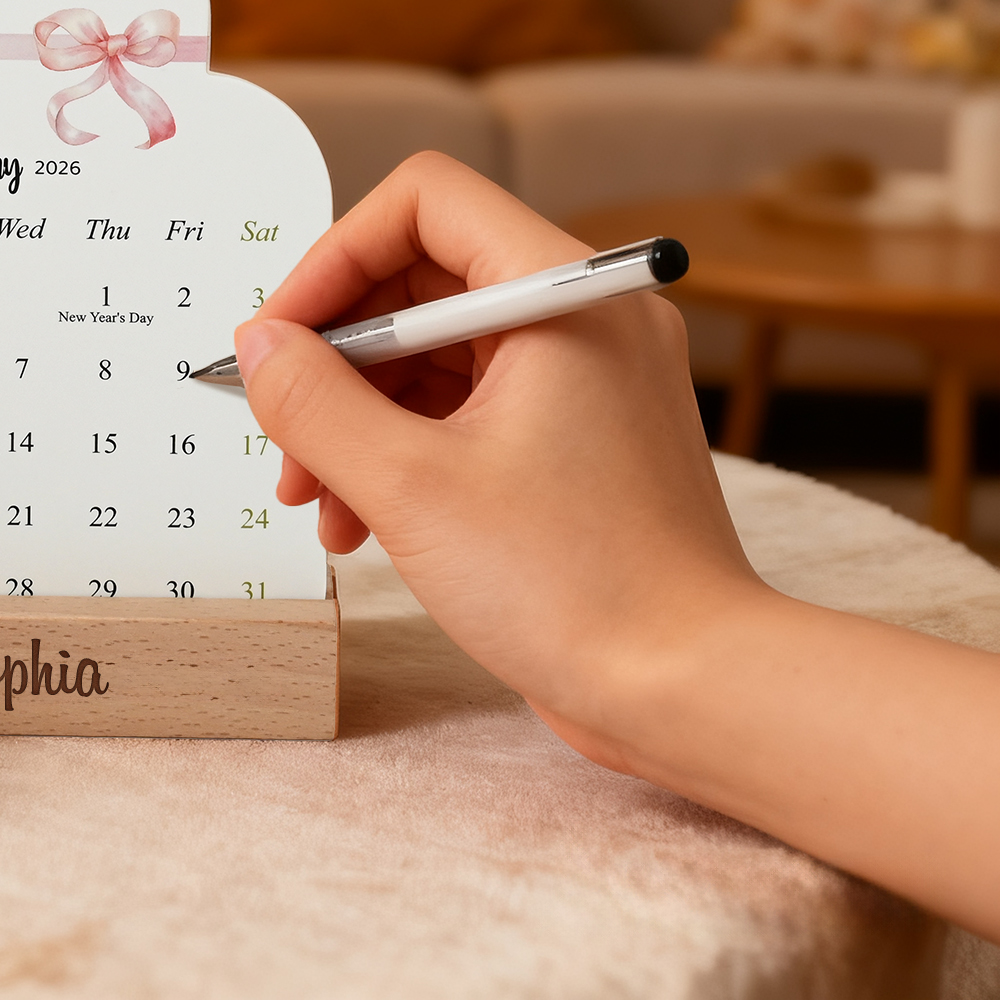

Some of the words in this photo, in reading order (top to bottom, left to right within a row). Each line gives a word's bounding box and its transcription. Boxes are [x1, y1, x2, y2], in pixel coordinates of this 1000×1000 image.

[34, 160, 81, 176] 2026
[85, 218, 131, 241] Thu
[164, 219, 205, 242] Fri
[240, 220, 280, 242] Sat
[101, 285, 111, 307] 1
[177, 286, 192, 308] 2
[252, 287, 265, 309] 3
[58, 310, 87, 323] New
[89, 311, 126, 324] Year's
[128, 311, 155, 327] Day
[14, 357, 29, 379] 7
[98, 358, 112, 381] 8
[176, 360, 191, 382] 9
[8, 431, 35, 453] 14
[91, 432, 118, 454] 15
[169, 433, 196, 456] 16
[243, 434, 269, 456] 17
[6, 504, 34, 527] 21
[88, 506, 118, 528] 22
[167, 507, 196, 529] 23
[240, 508, 270, 530] 24
[5, 577, 34, 597] 28
[88, 579, 118, 598] 29
[166, 580, 195, 599] 30
[241, 581, 265, 600] 31
